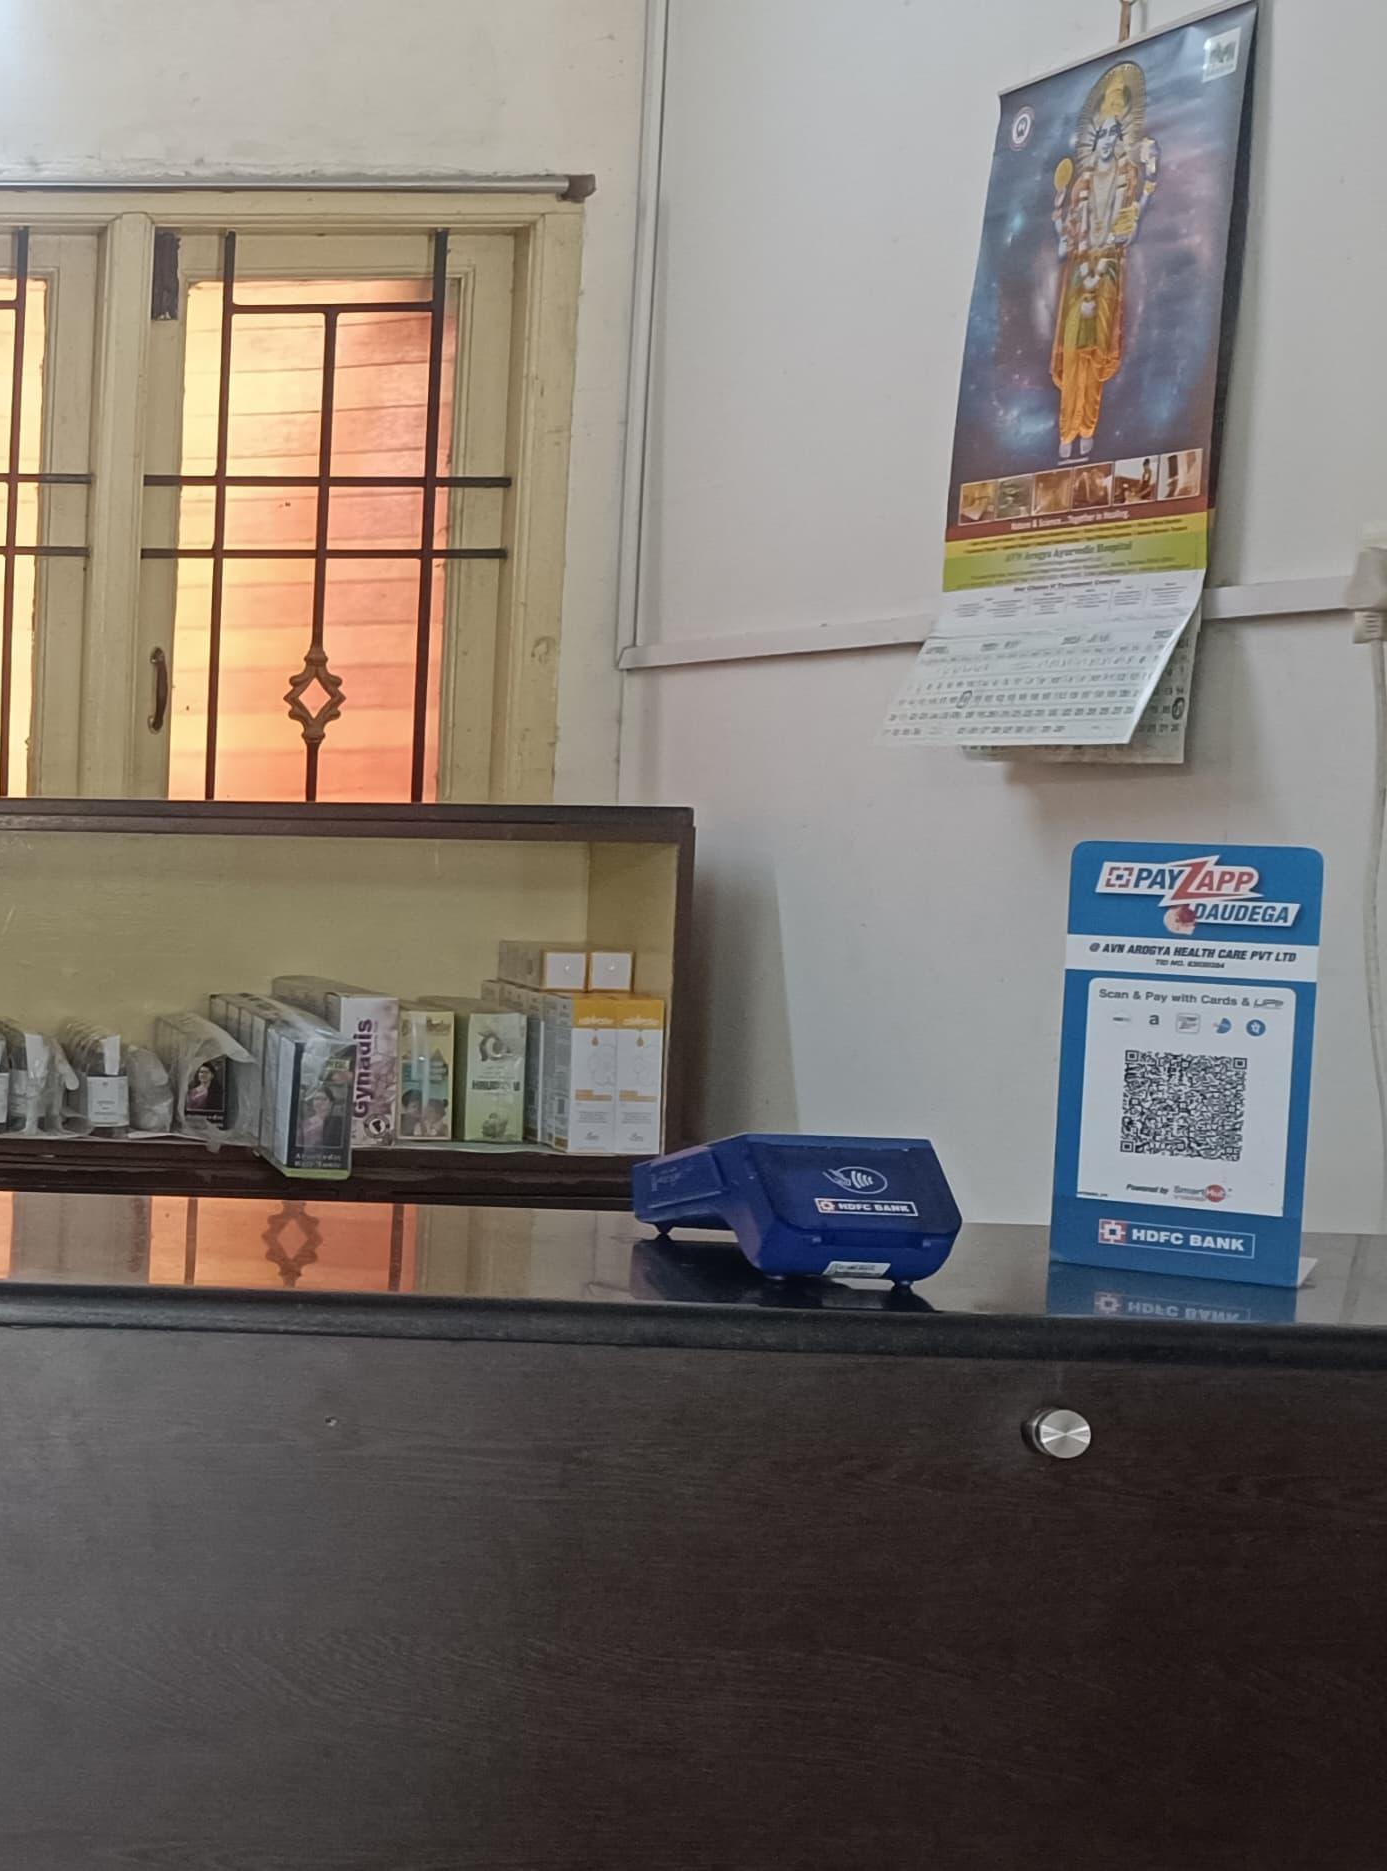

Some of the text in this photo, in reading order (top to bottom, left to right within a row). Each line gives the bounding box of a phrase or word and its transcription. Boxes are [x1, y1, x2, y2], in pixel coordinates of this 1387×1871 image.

[1133, 860, 1255, 900] PAYZAPP
[1194, 902, 1289, 924] DAUDEGA
[1102, 943, 1124, 954] AVN
[1126, 944, 1172, 956] AROGYA
[1173, 946, 1216, 958] HEALTH
[1218, 948, 1249, 960] CARE
[1250, 951, 1273, 962] PVT
[1275, 952, 1297, 963] LTD
[1099, 988, 1129, 1000] Scan
[1132, 990, 1141, 1000] &
[1145, 992, 1167, 1004] Pay
[1171, 993, 1197, 1004] with
[1200, 994, 1238, 1007] Cards
[1241, 997, 1250, 1007] &
[353, 1018, 375, 1118] Gynadis
[838, 1202, 910, 1214] HDFC BANK
[1132, 1228, 1245, 1251] HDFC BANK
